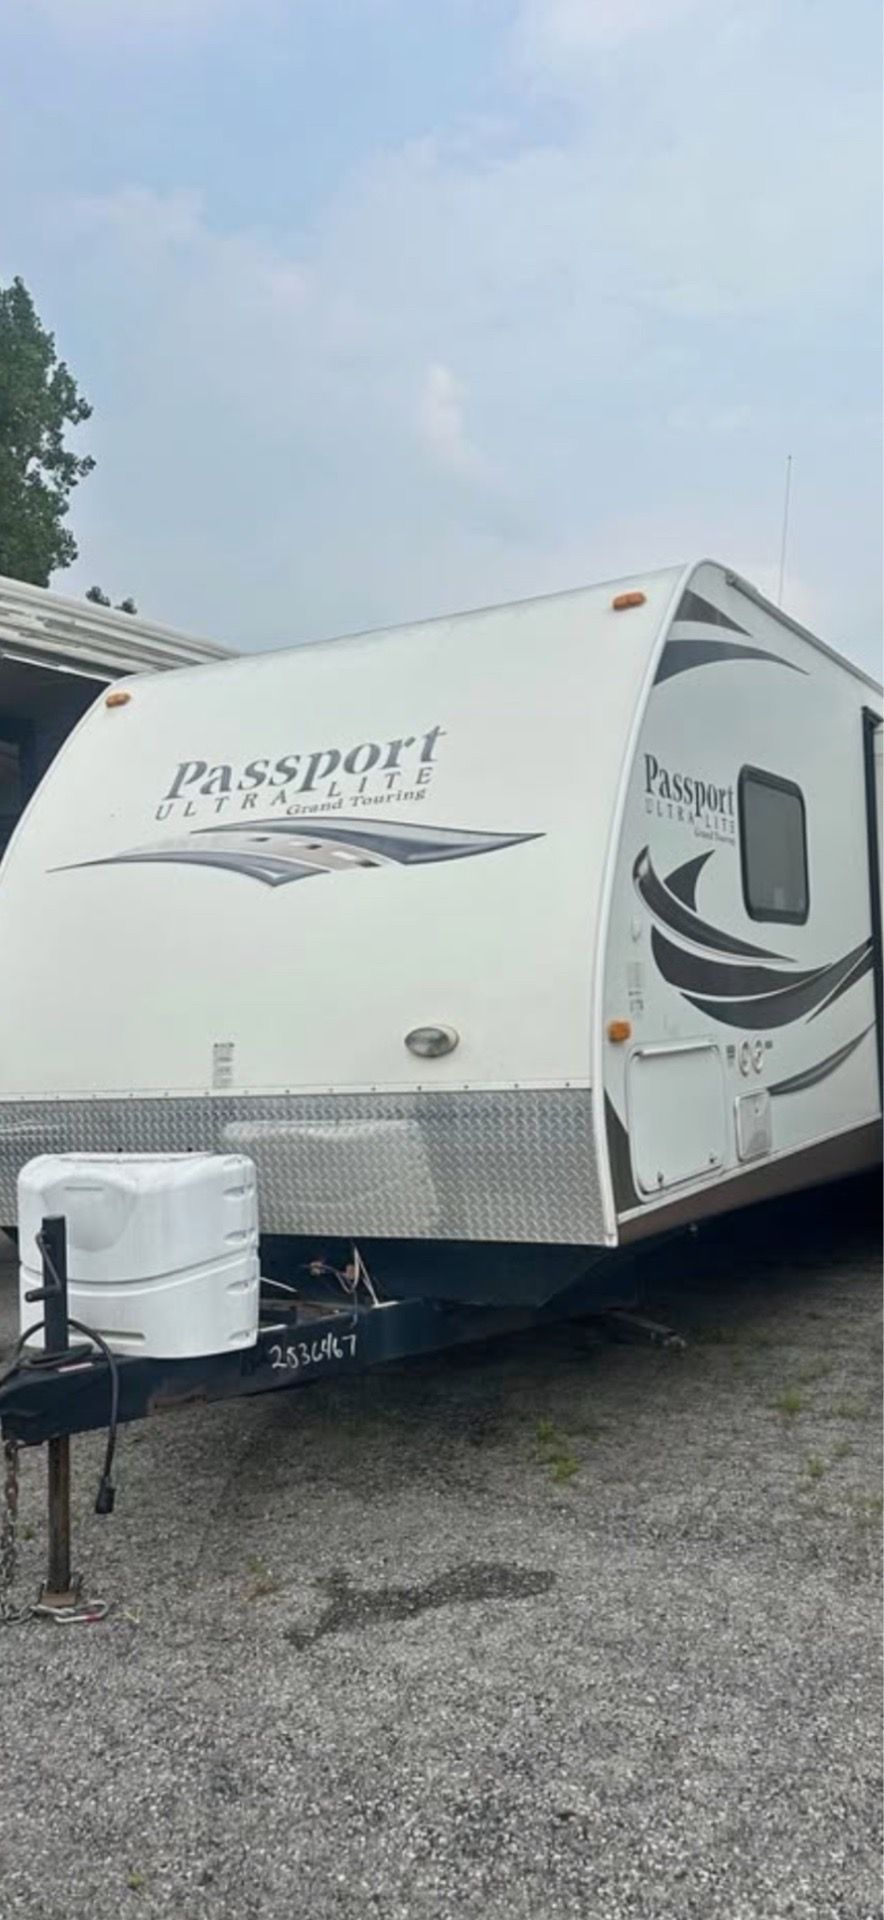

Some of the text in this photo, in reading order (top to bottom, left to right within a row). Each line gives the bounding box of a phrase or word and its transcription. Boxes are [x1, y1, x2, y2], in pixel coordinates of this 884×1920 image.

[164, 725, 447, 801] Passport
[644, 753, 734, 817] Passport
[154, 767, 434, 821] ULTRA LITE
[286, 788, 426, 816] Grand Touring
[645, 798, 695, 825] ULTRA
